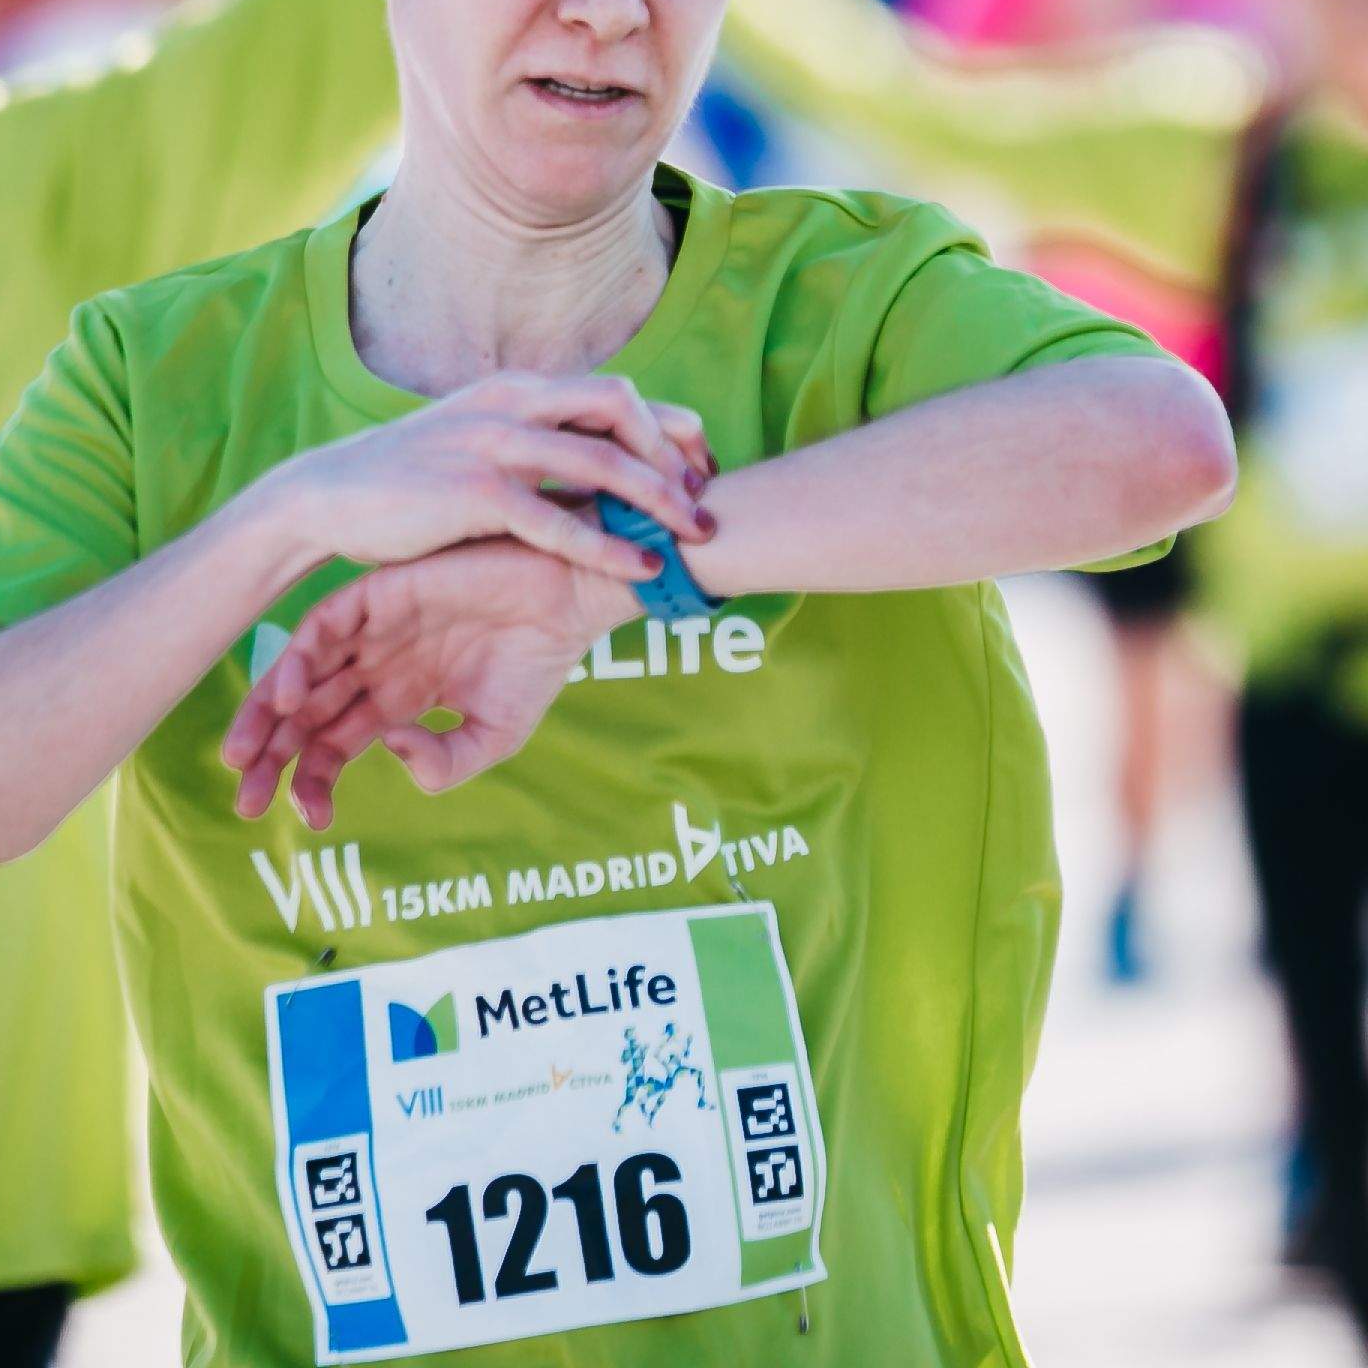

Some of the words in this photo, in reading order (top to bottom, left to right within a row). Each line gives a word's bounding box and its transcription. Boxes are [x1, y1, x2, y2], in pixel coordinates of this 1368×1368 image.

[565, 615, 766, 684] Life
[250, 842, 373, 933] VIII
[381, 881, 492, 923] 15KM
[475, 964, 677, 1039] MetLife
[396, 1084, 444, 1120] VIII
[425, 1152, 692, 1307] 1216
